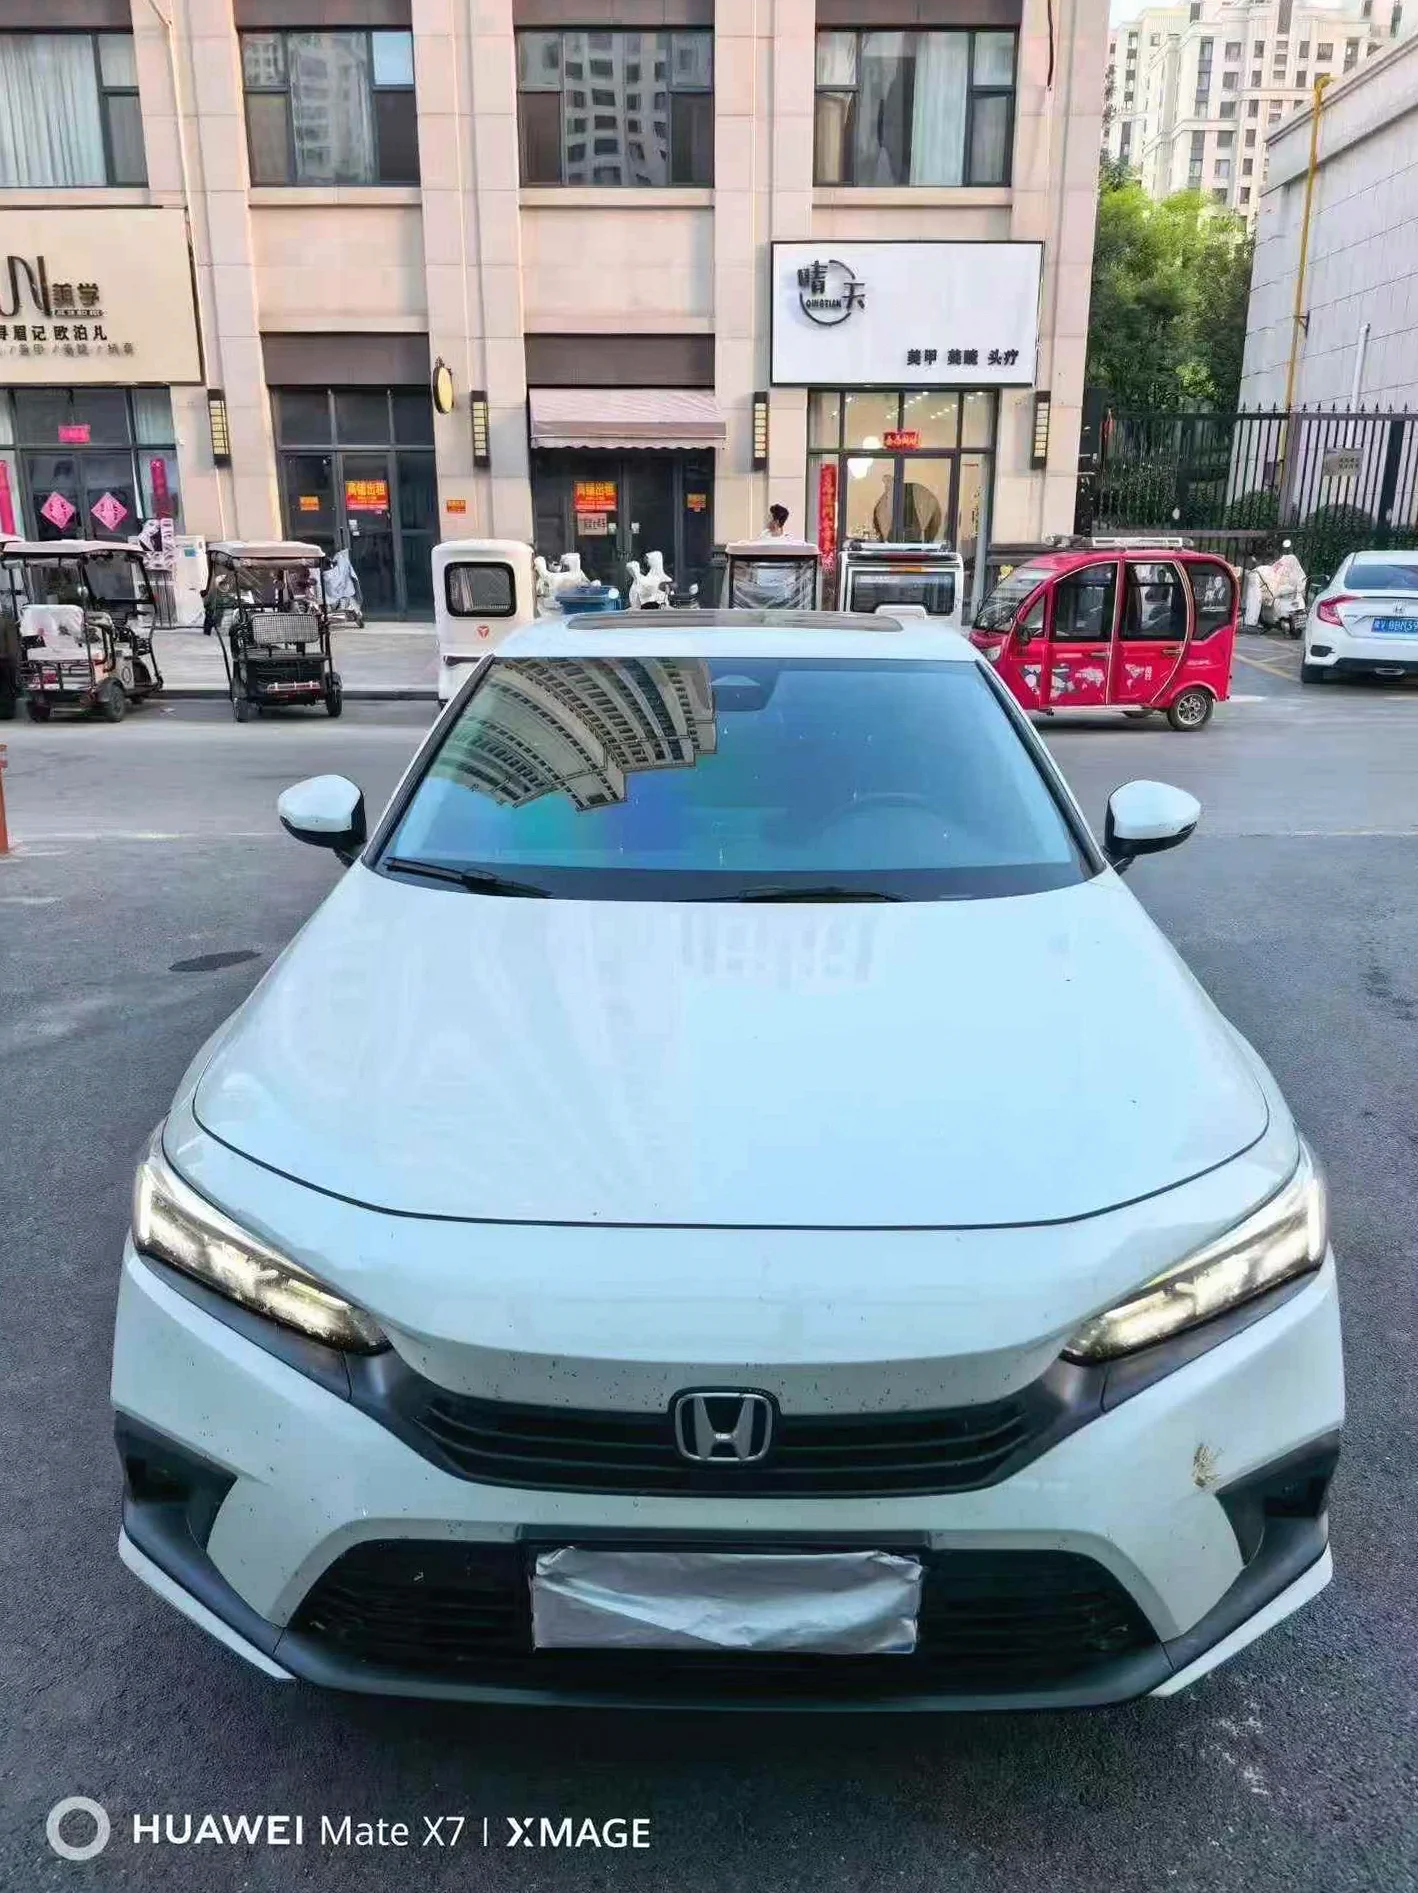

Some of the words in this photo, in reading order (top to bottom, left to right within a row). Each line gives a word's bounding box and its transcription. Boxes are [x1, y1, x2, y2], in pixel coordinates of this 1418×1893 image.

[798, 260, 865, 313] 晴天
[907, 349, 937, 365] 美甲
[988, 349, 1019, 366] 头疗
